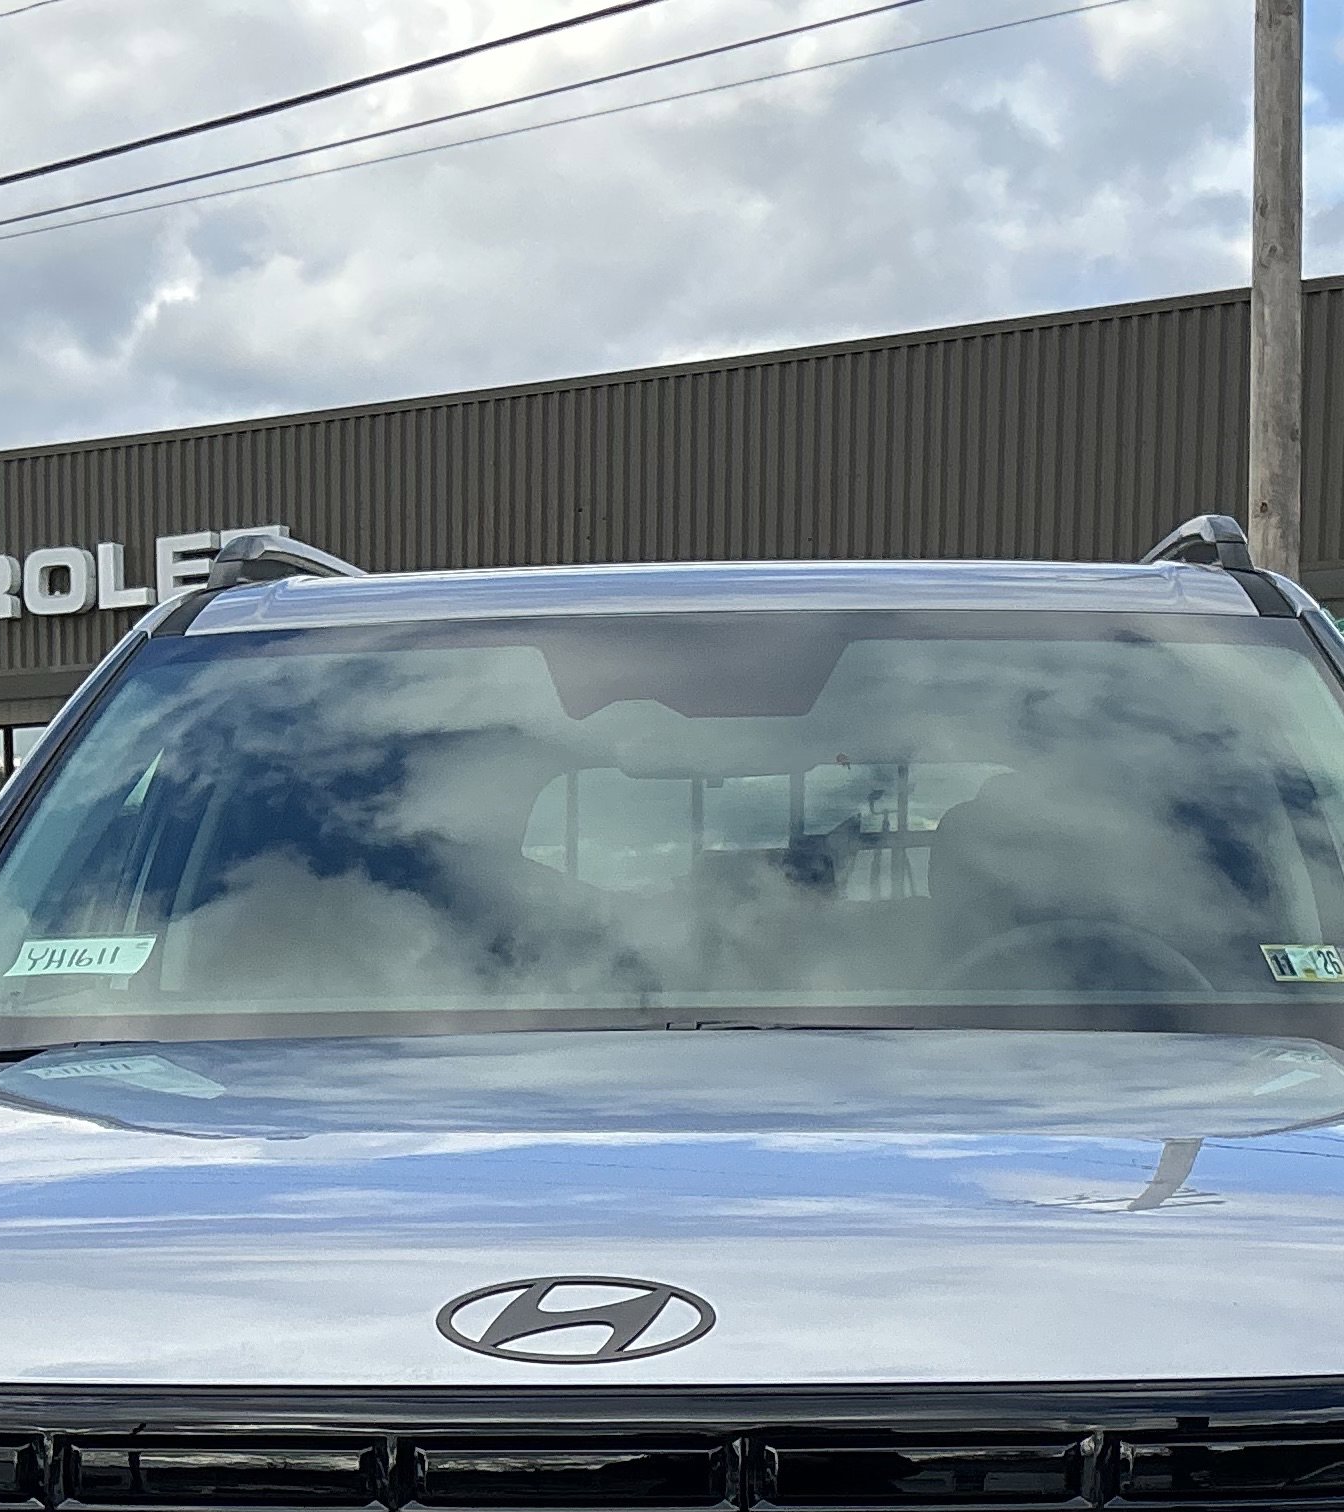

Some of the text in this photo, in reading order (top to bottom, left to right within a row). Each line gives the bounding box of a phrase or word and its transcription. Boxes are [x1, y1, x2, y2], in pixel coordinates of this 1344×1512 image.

[27, 946, 121, 972] YH1611
[1270, 950, 1343, 977] 11 26
